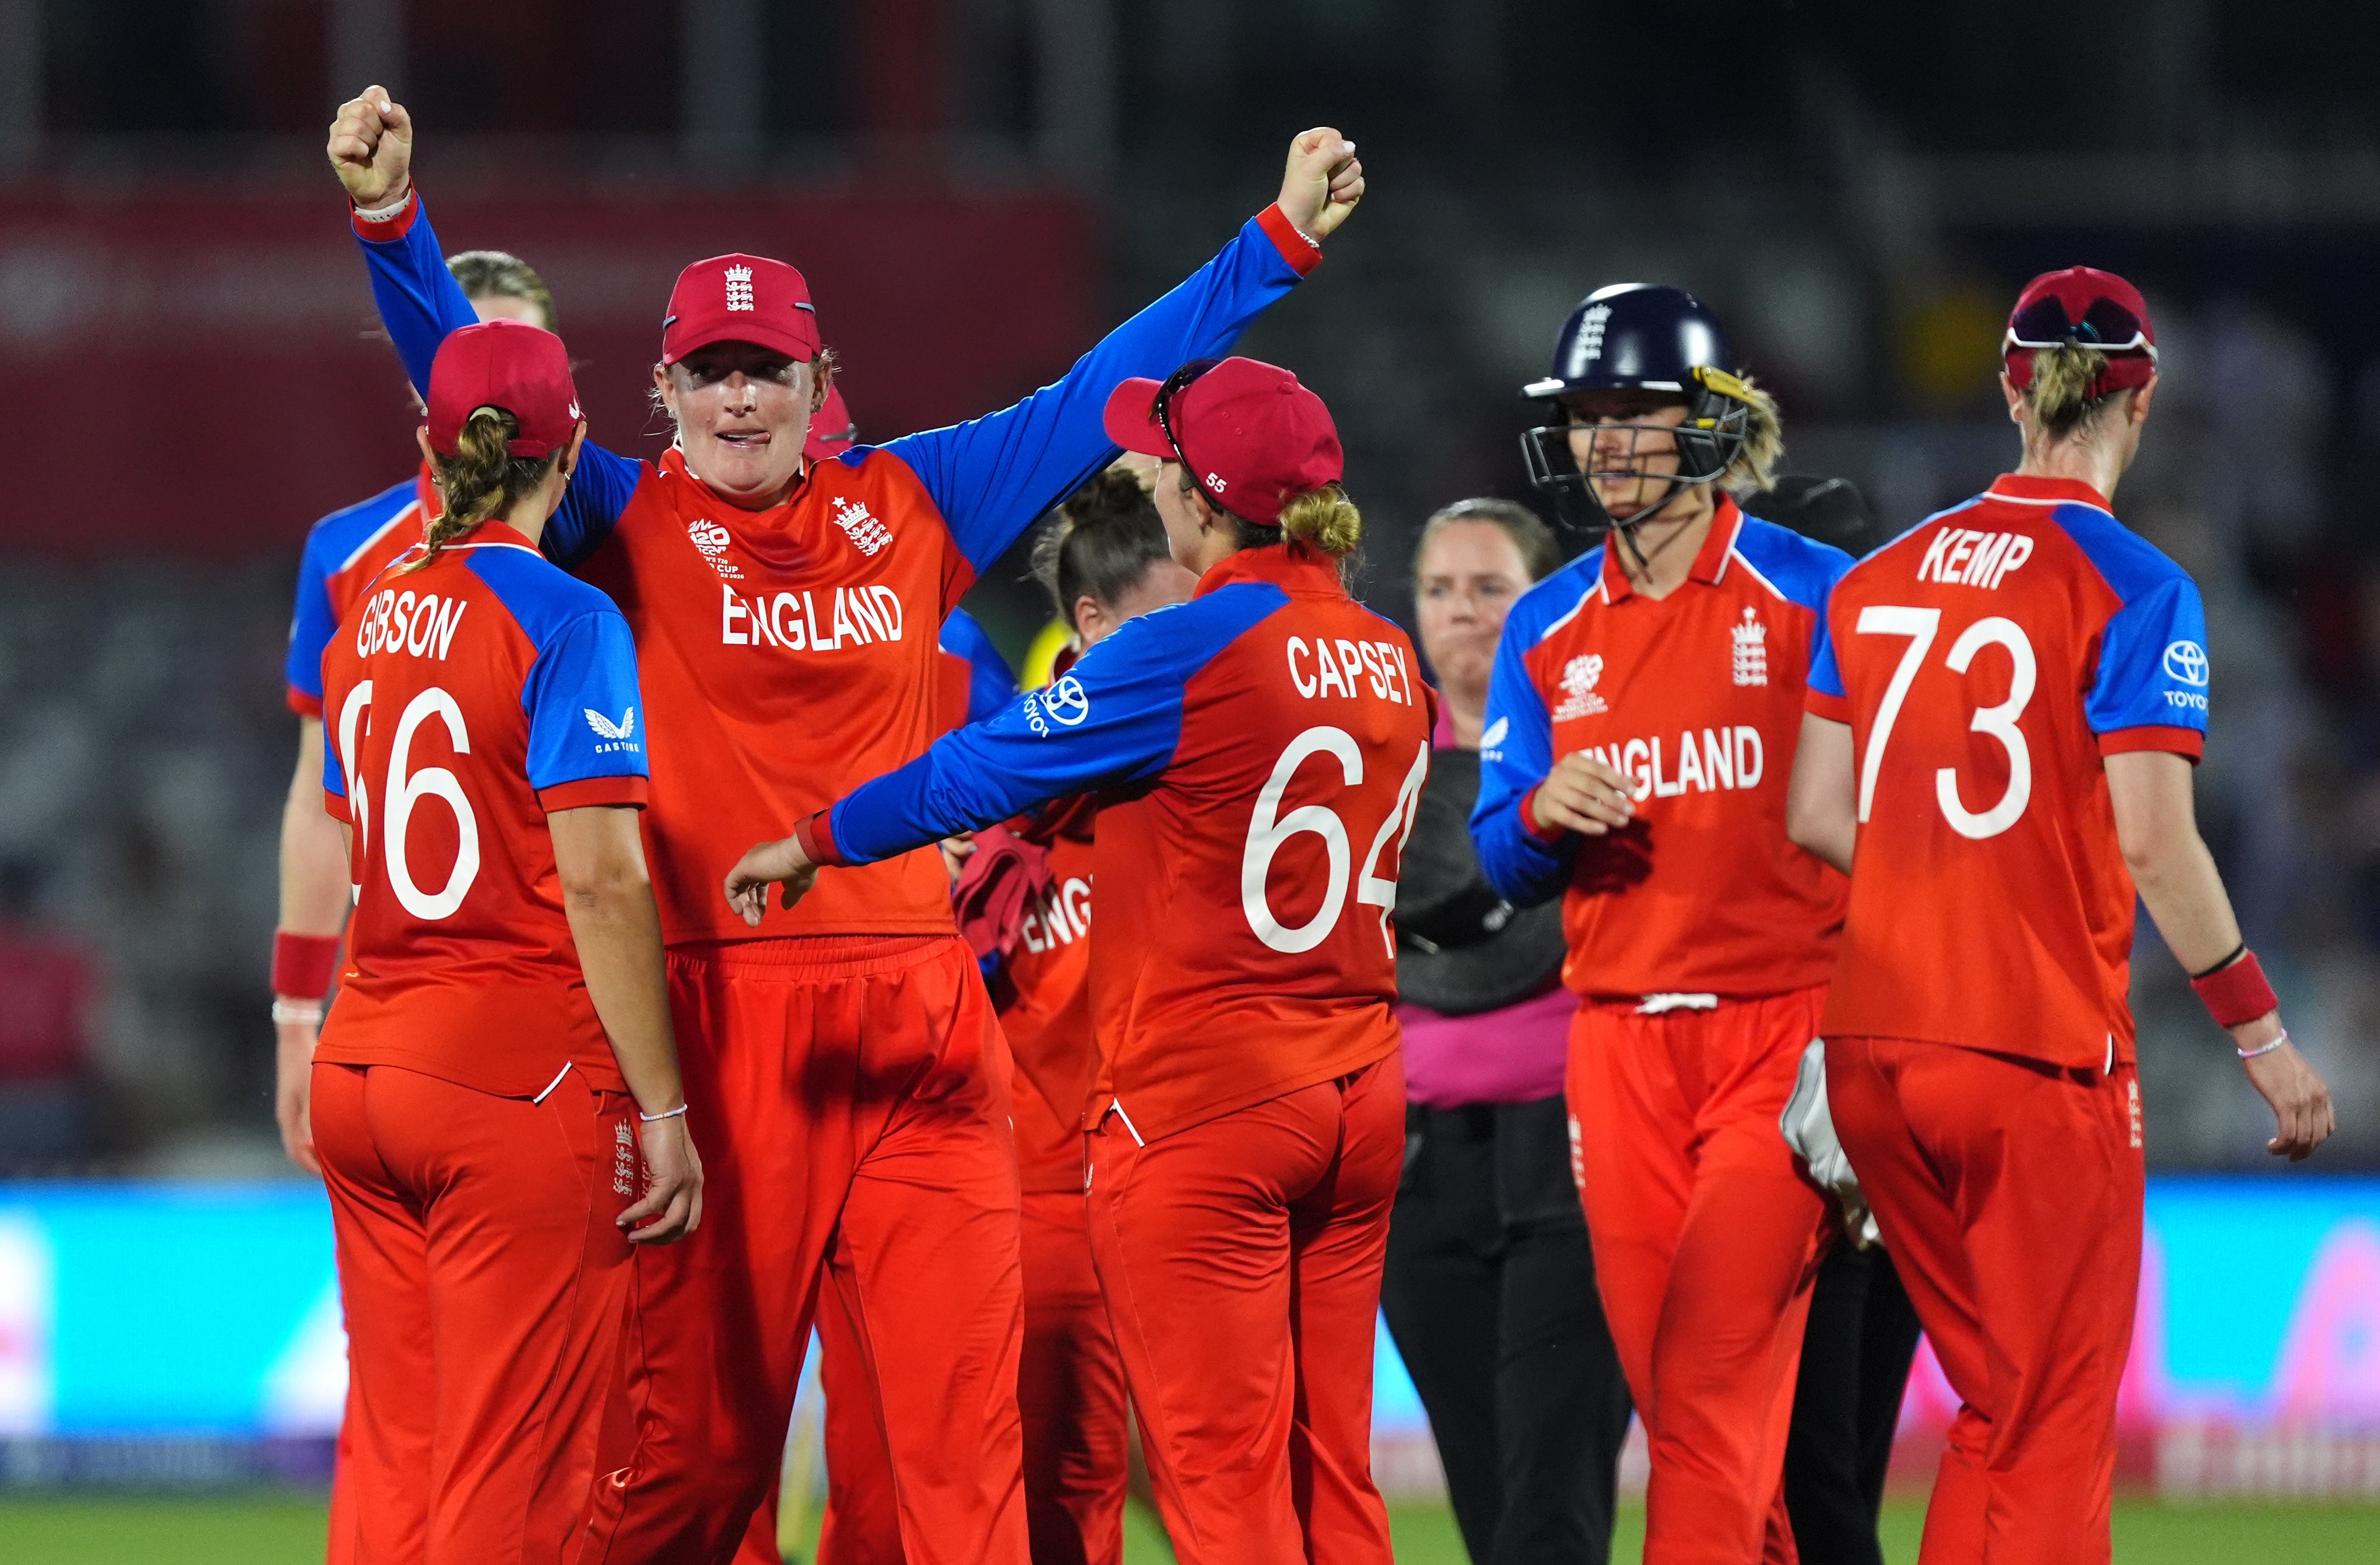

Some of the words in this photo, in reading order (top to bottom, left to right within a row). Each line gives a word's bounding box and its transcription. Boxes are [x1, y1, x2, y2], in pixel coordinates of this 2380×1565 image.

[1206, 472, 1227, 493] 55
[717, 564, 738, 573] CUP
[1917, 526, 2034, 590] KEMP
[356, 589, 467, 661] GIBSON
[722, 583, 902, 651] ENGLAND
[1287, 636, 1412, 706] CAPSEY
[2163, 691, 2209, 710] TOYO
[1856, 605, 2036, 839] 73
[1242, 726, 1428, 959] 64
[1021, 873, 1093, 954] ENG
